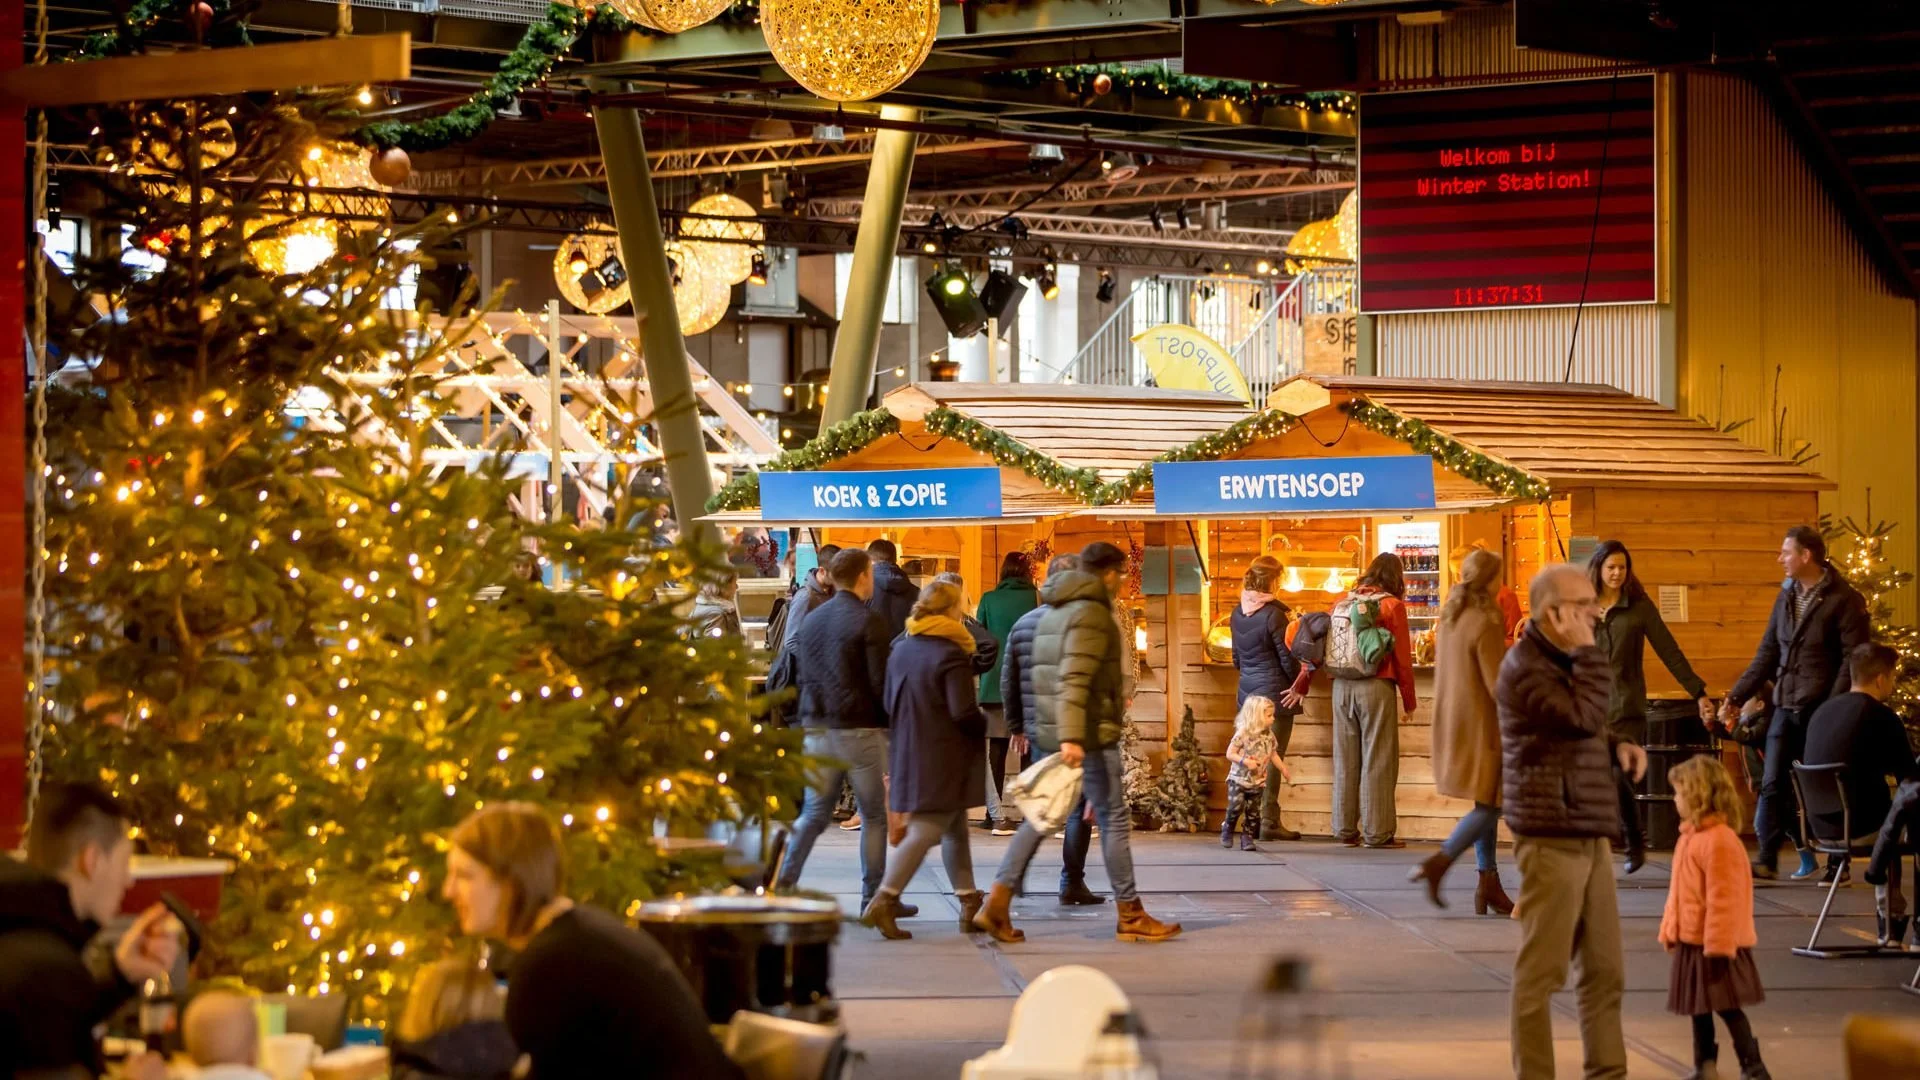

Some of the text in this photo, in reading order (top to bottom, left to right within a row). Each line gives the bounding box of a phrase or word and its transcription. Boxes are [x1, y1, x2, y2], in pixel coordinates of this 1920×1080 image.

[1440, 142, 1556, 168] Welkom bij
[1417, 168, 1590, 197] Winter Station!
[1454, 284, 1544, 306] 11:37:31
[813, 482, 948, 508] KOEK & ZOPIE
[1219, 471, 1366, 500] ERWTENSOEP
